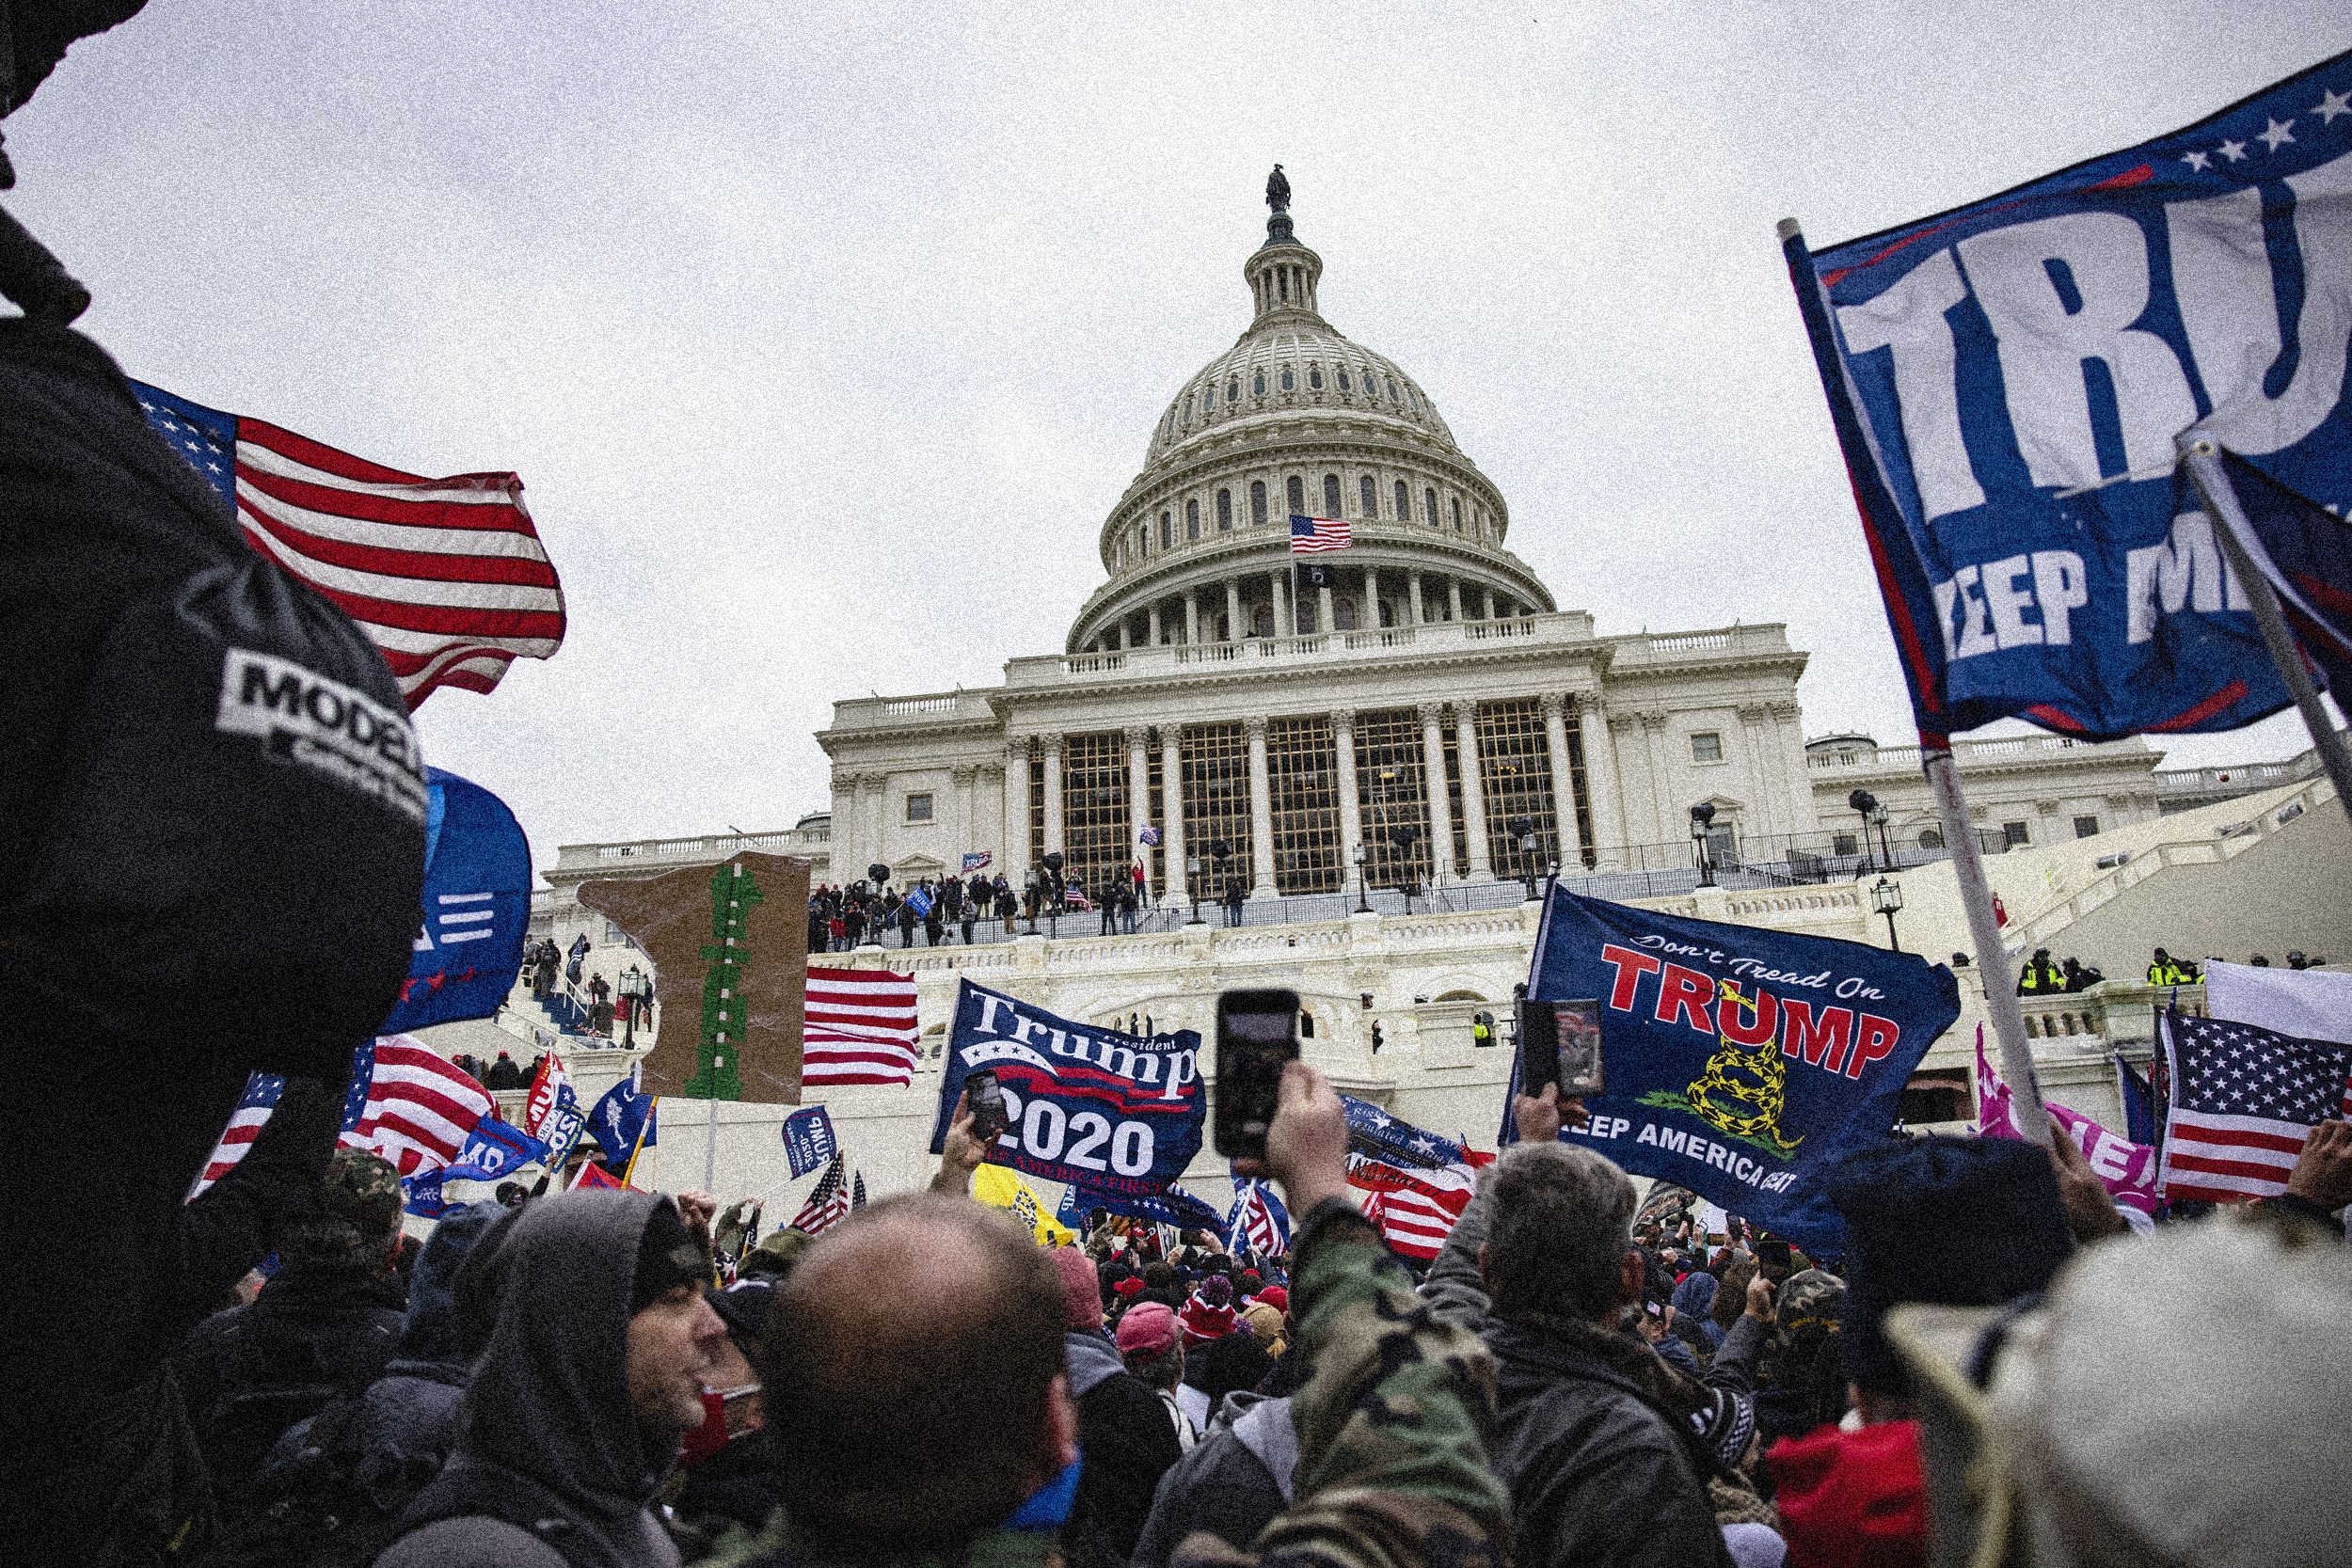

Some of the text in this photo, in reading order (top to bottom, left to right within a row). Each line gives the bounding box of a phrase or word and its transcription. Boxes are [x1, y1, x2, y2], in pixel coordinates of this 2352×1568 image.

[1629, 935, 1885, 1001] Don't Tread On
[969, 988, 1197, 1101] Trump
[1601, 942, 1900, 1081] TRUMP
[1014, 1155, 1102, 1187] AMERICA
[1379, 1165, 1422, 1189] TAKE
[1636, 1123, 1764, 1189] AMERICA
